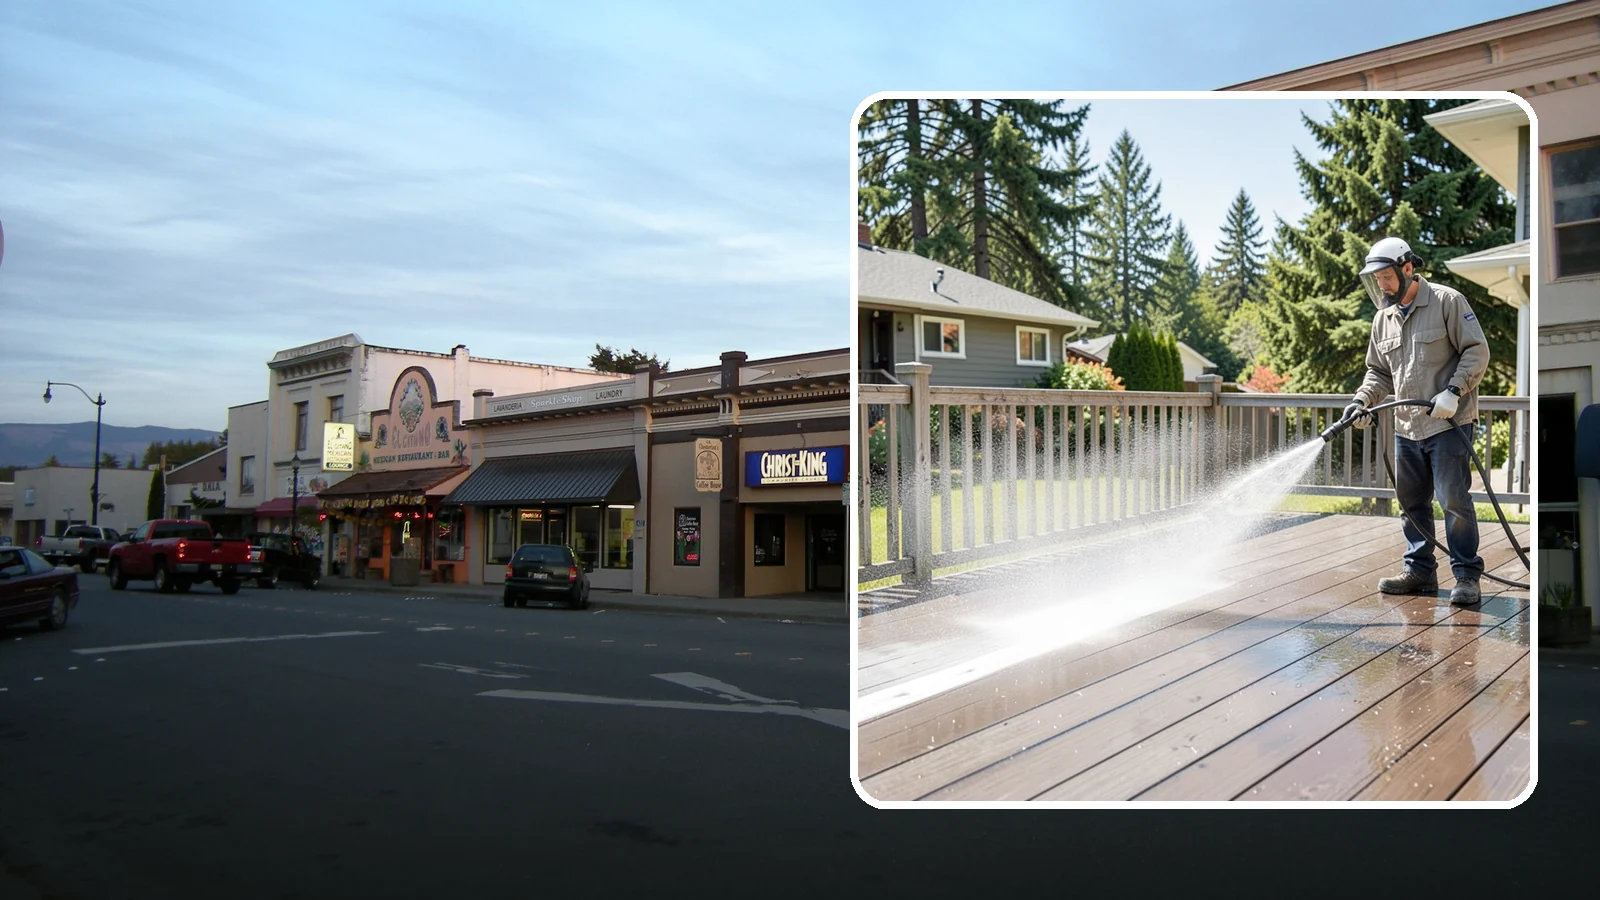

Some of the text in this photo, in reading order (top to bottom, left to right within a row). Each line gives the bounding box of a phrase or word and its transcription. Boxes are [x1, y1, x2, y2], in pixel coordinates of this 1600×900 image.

[595, 389, 623, 400] LAUNDRY
[494, 402, 522, 412] LAVANDERIA
[531, 395, 582, 409] Sparkle Shop
[373, 451, 450, 464] MEXICAN RESTAURANT BAR
[761, 450, 827, 478] CHRIST KING
